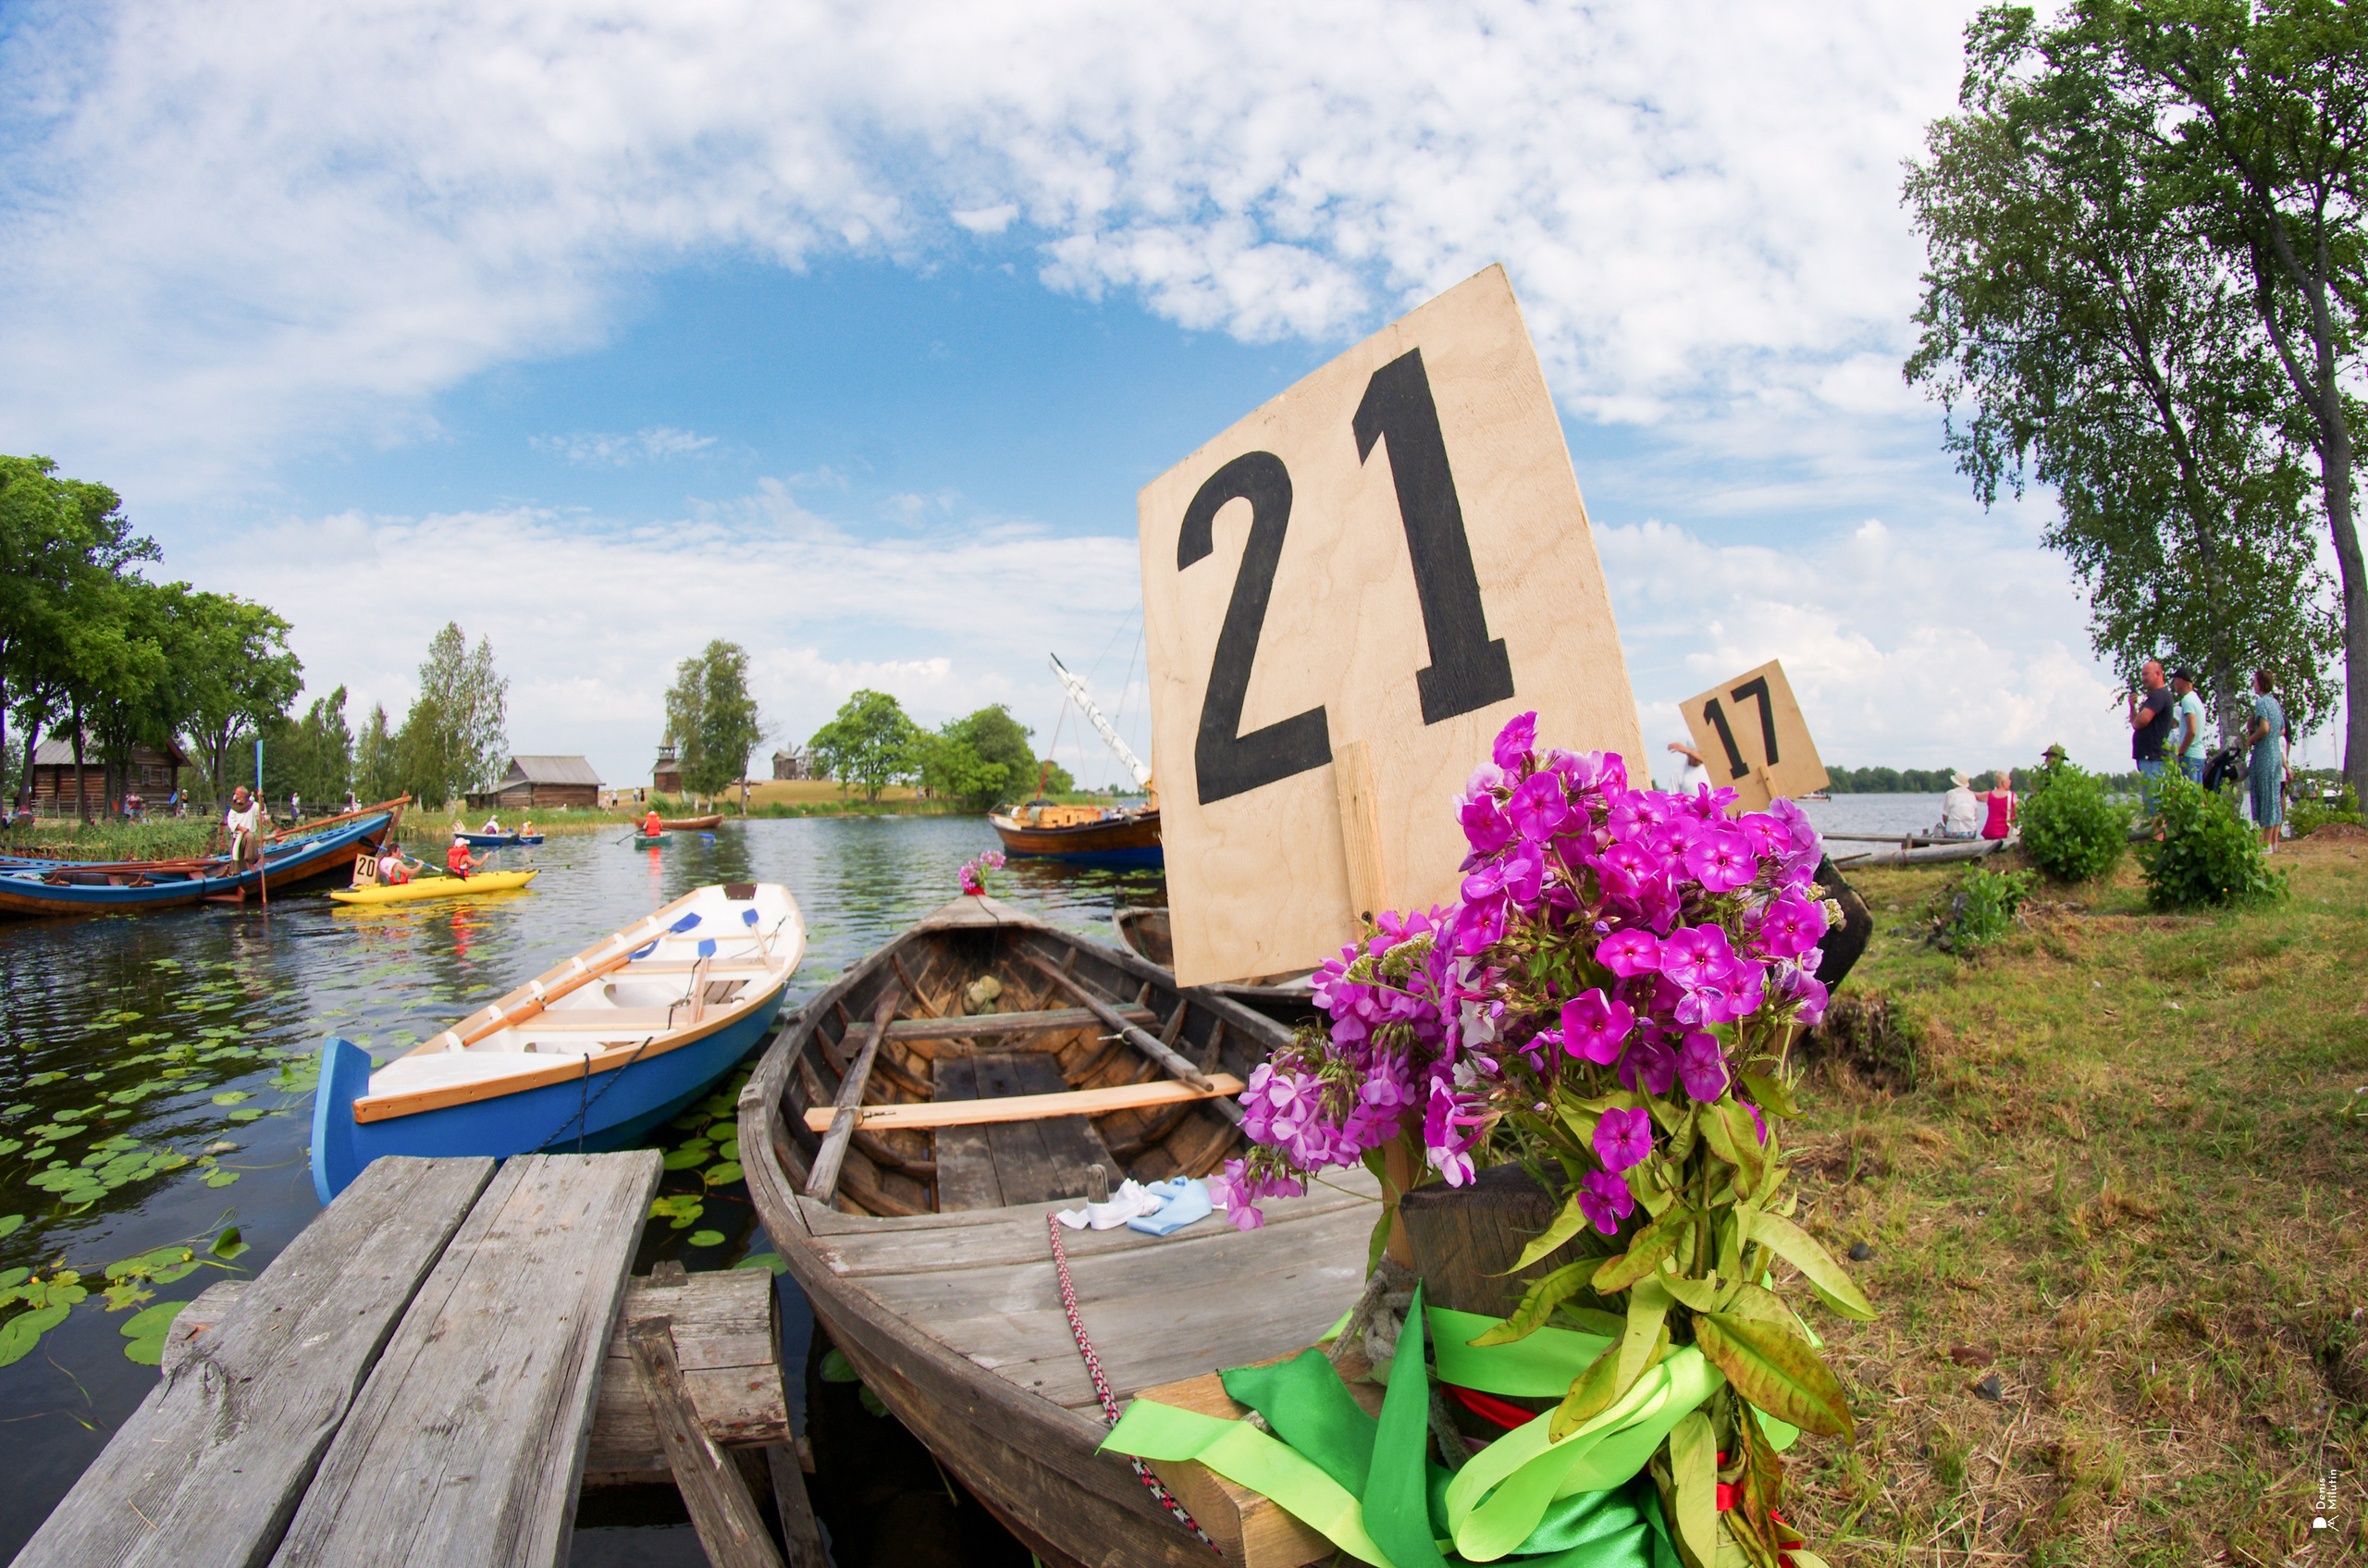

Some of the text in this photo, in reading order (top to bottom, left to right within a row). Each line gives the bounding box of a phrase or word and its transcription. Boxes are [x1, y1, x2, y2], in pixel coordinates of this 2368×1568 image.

[1178, 346, 1515, 806] 21
[1703, 674, 1780, 781] 17
[357, 857, 376, 878] 20
